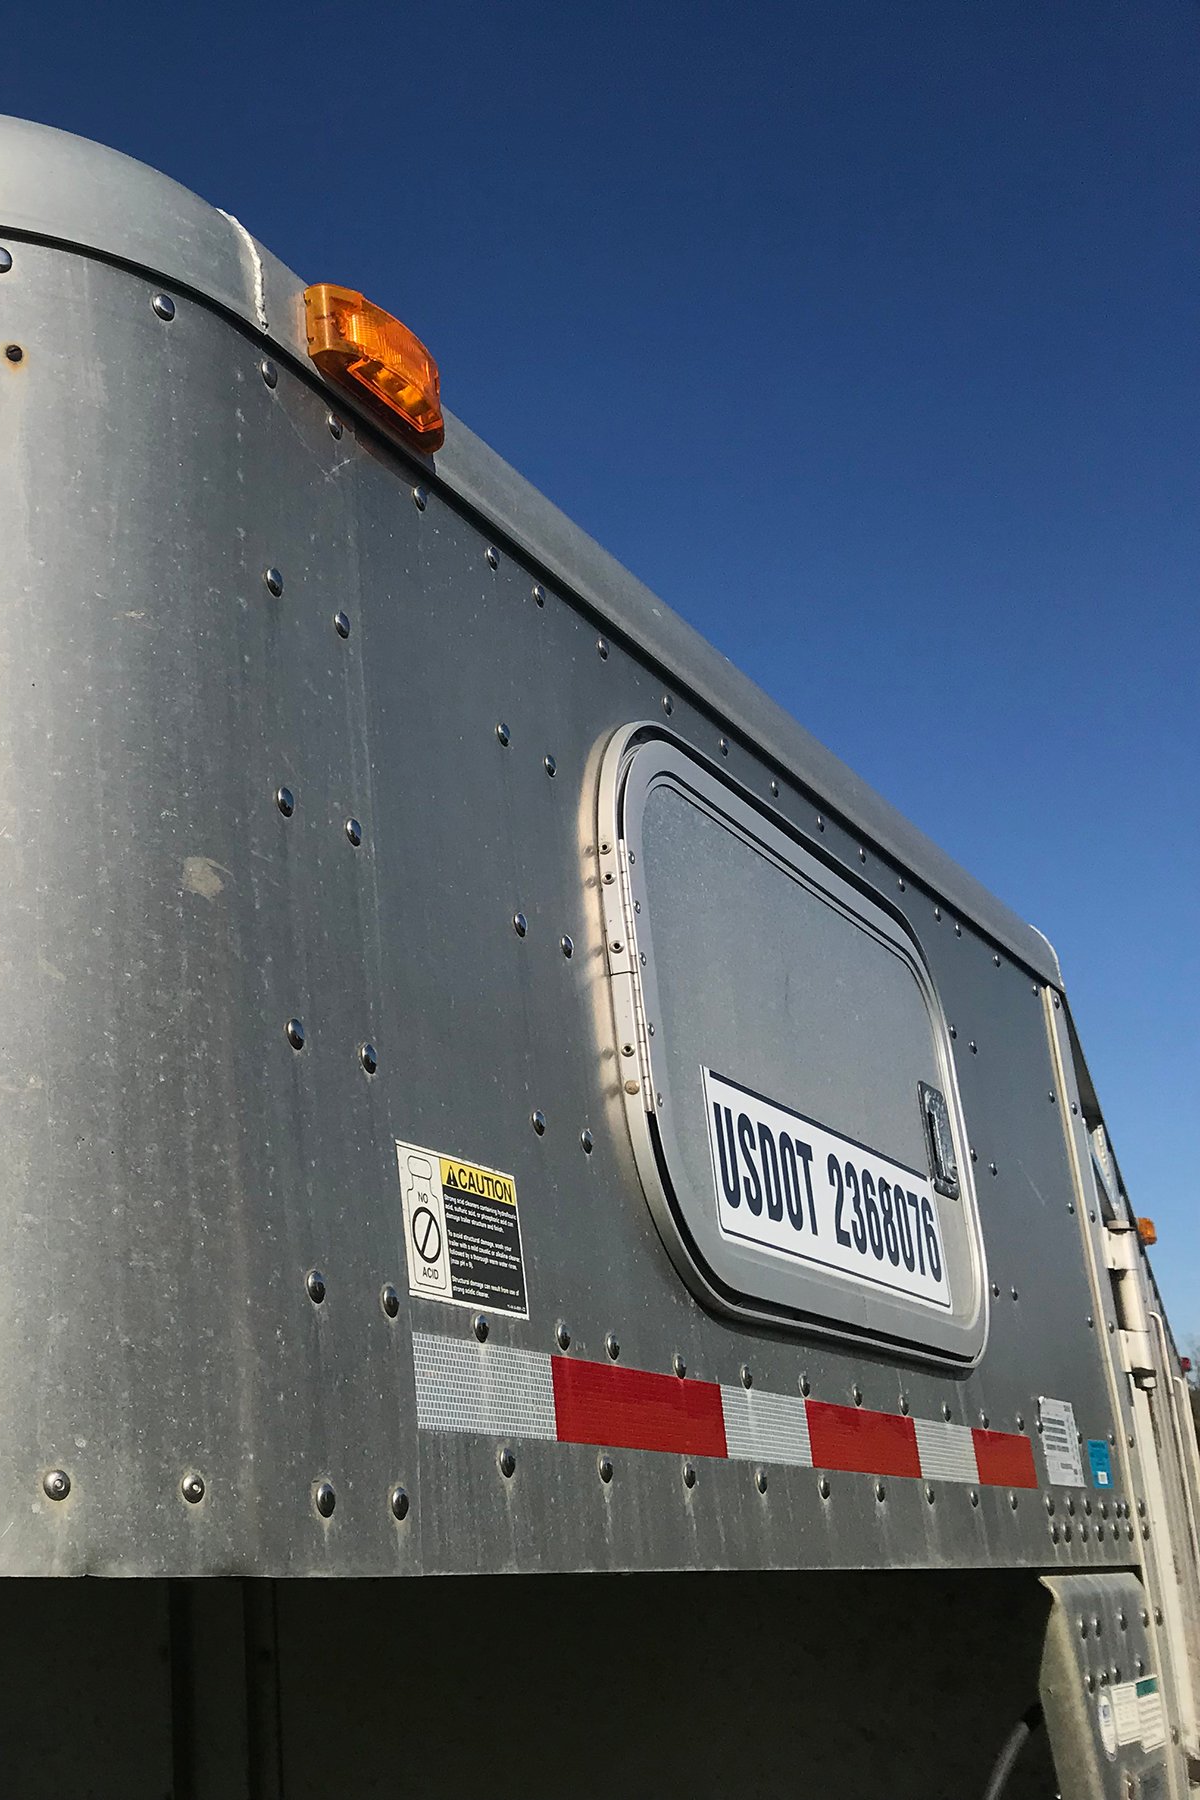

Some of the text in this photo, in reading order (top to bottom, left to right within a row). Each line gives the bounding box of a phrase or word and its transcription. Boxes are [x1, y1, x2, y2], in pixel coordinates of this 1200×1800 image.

[417, 1191, 429, 1204] NO
[458, 1168, 513, 1204] CAUTION
[714, 1101, 942, 1283] USDOT 2368076
[422, 1266, 439, 1281] ACID
